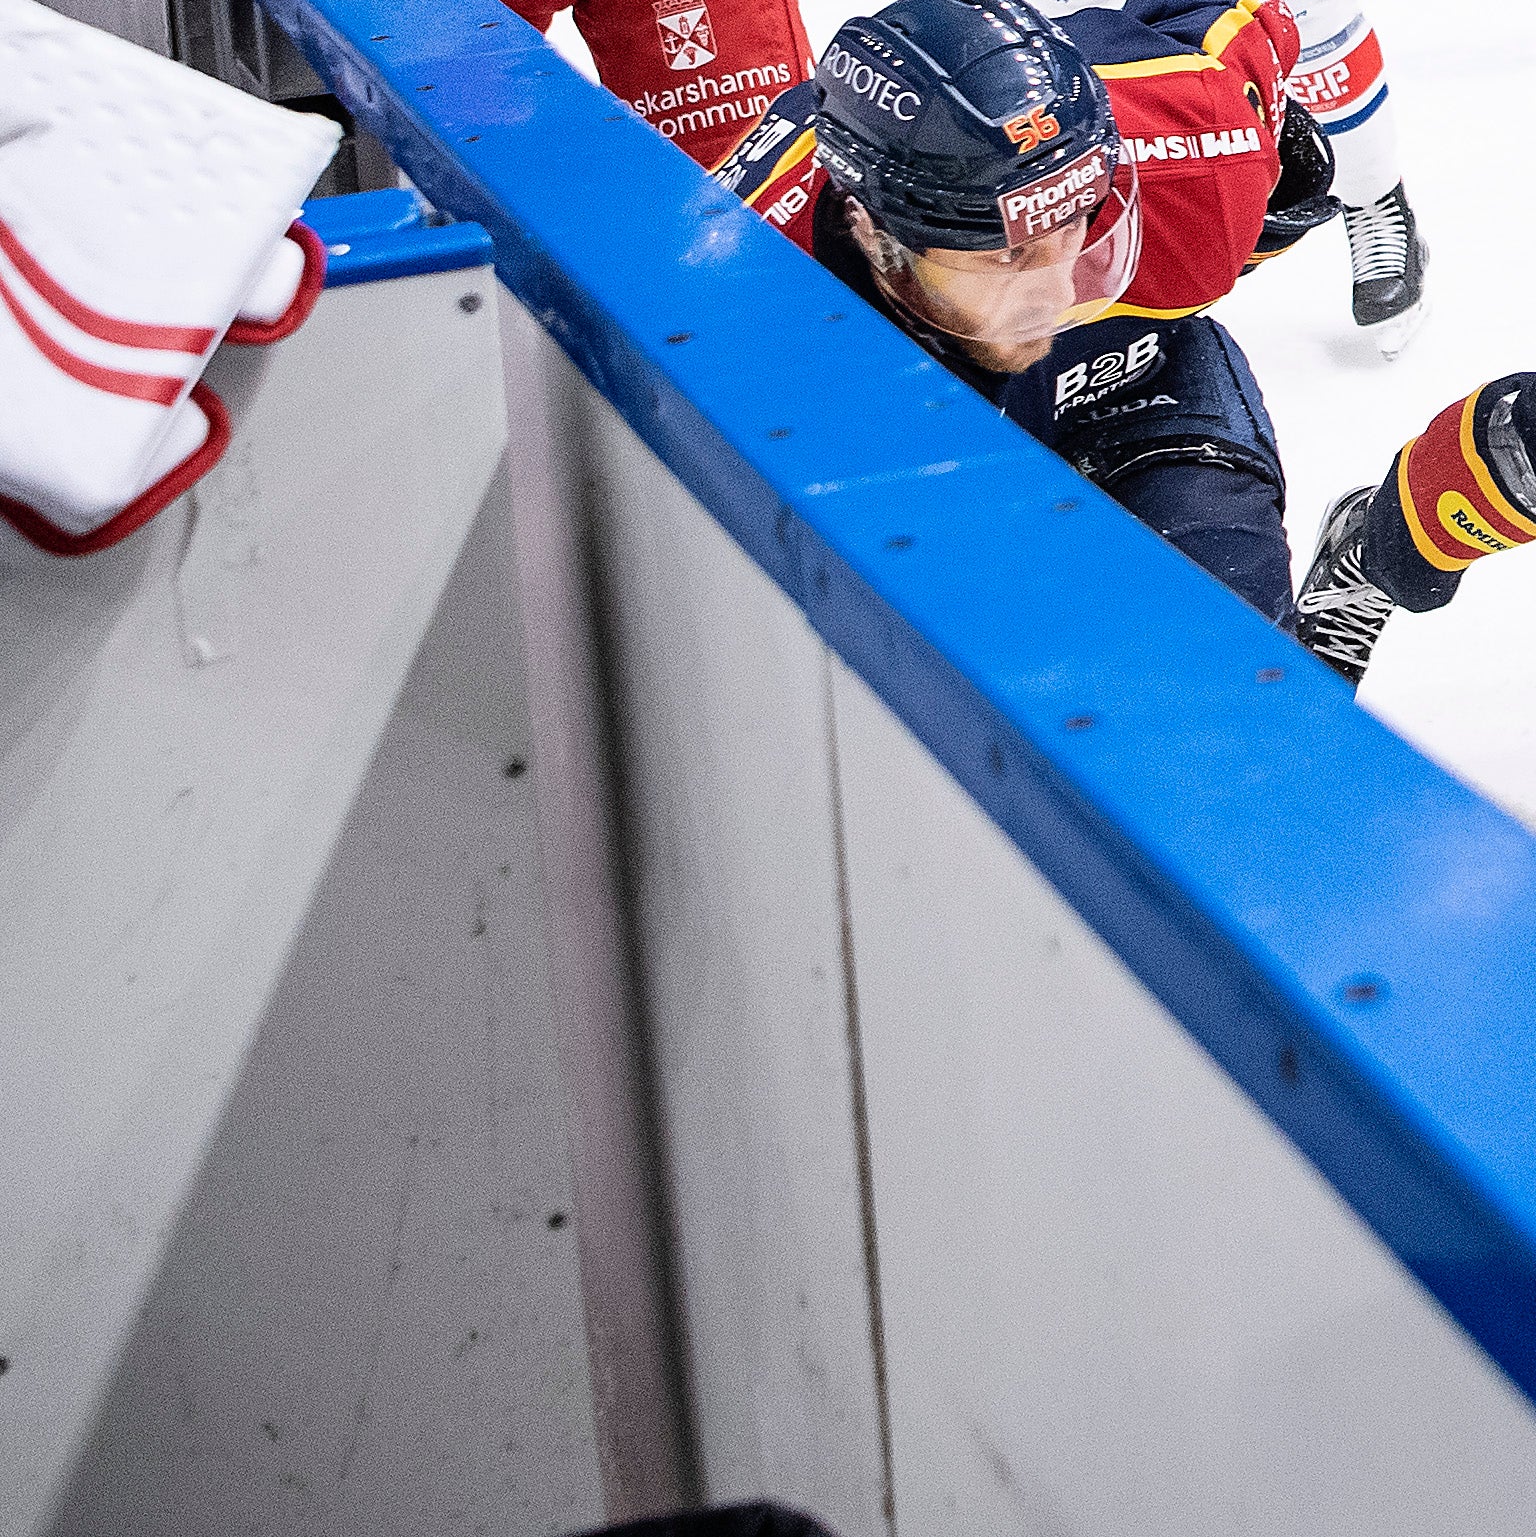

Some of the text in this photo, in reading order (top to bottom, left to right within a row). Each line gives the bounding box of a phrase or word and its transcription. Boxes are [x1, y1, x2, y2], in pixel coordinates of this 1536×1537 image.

[822, 42, 922, 122] ROTOTEC
[650, 94, 772, 139] ommun
[1001, 102, 1062, 155] 56
[1006, 152, 1107, 224] Prioritet
[1025, 187, 1098, 238] Finans
[1055, 331, 1161, 406] B2B
